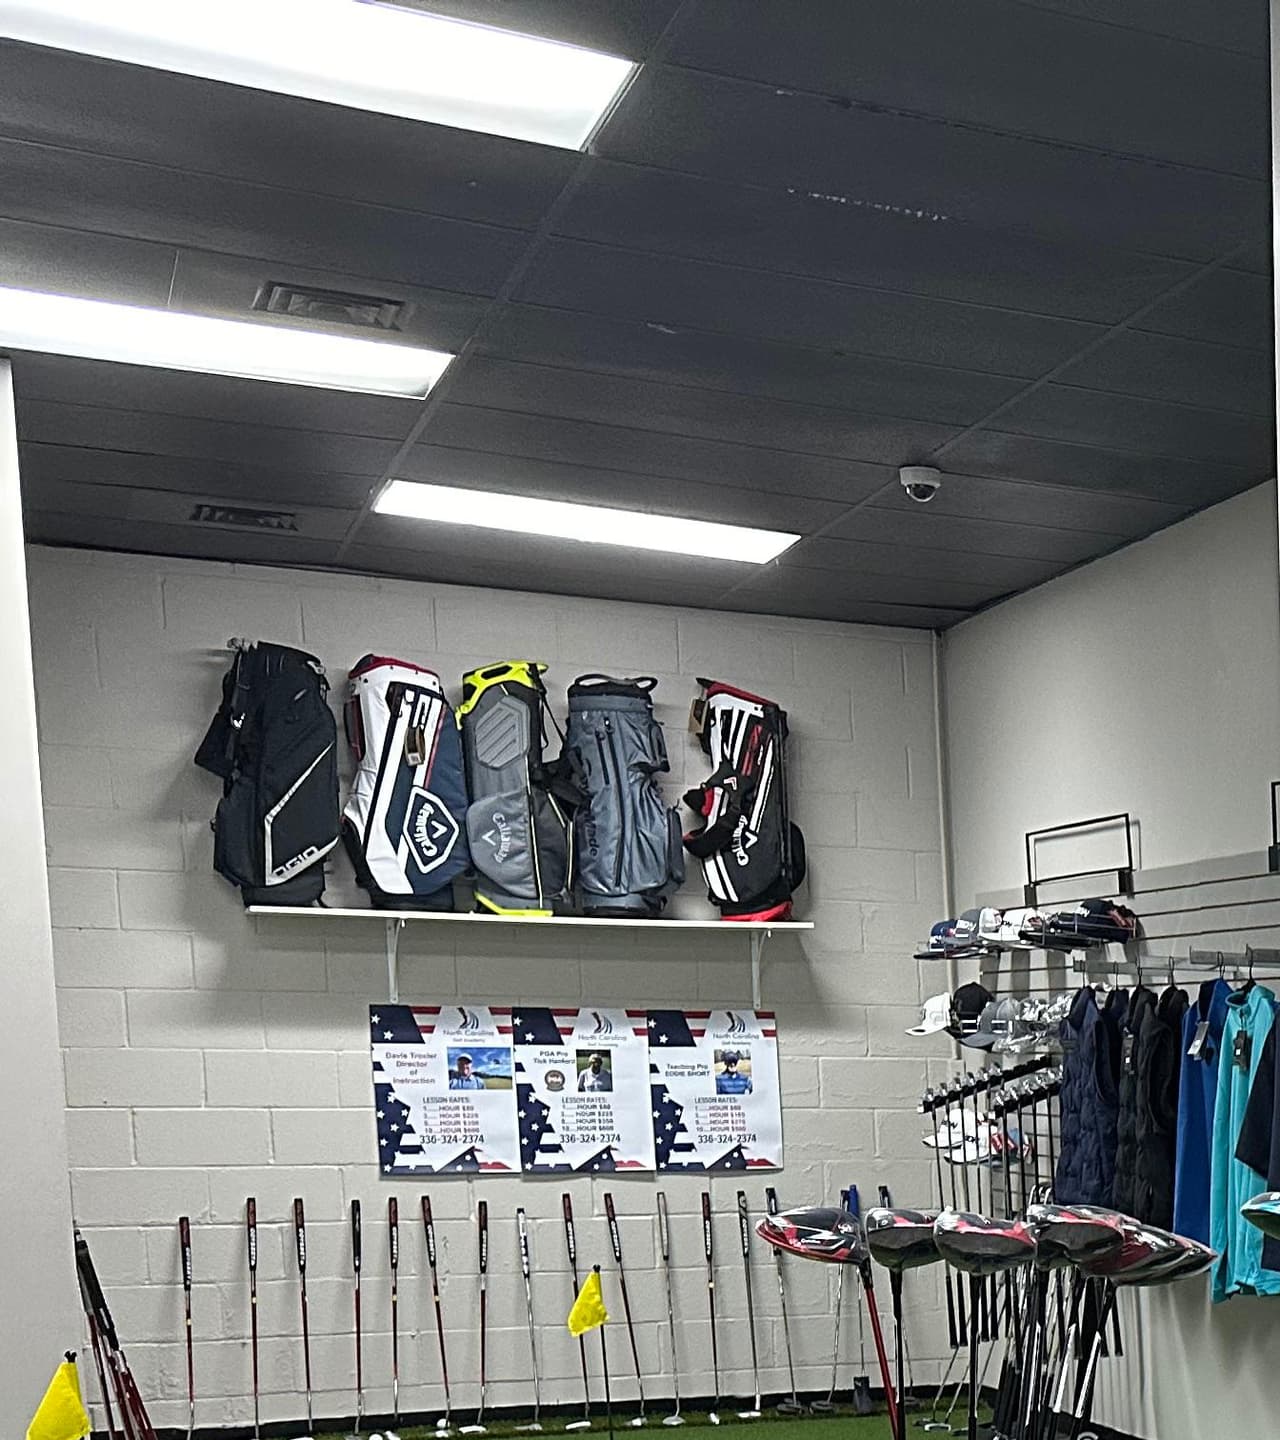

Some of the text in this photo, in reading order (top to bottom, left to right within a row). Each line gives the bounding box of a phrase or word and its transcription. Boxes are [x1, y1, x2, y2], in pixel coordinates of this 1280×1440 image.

[414, 803, 438, 857] Callaway
[492, 812, 512, 864] Callaway
[272, 846, 319, 877] OGIO
[393, 1076, 436, 1085] Instruction
[423, 1096, 448, 1104] LESSON
[562, 1096, 585, 1104] LESSON
[419, 1134, 485, 1145] 336-324-2374
[559, 1133, 621, 1144] 336-324-2374
[697, 1133, 757, 1144] 336-324-2374
